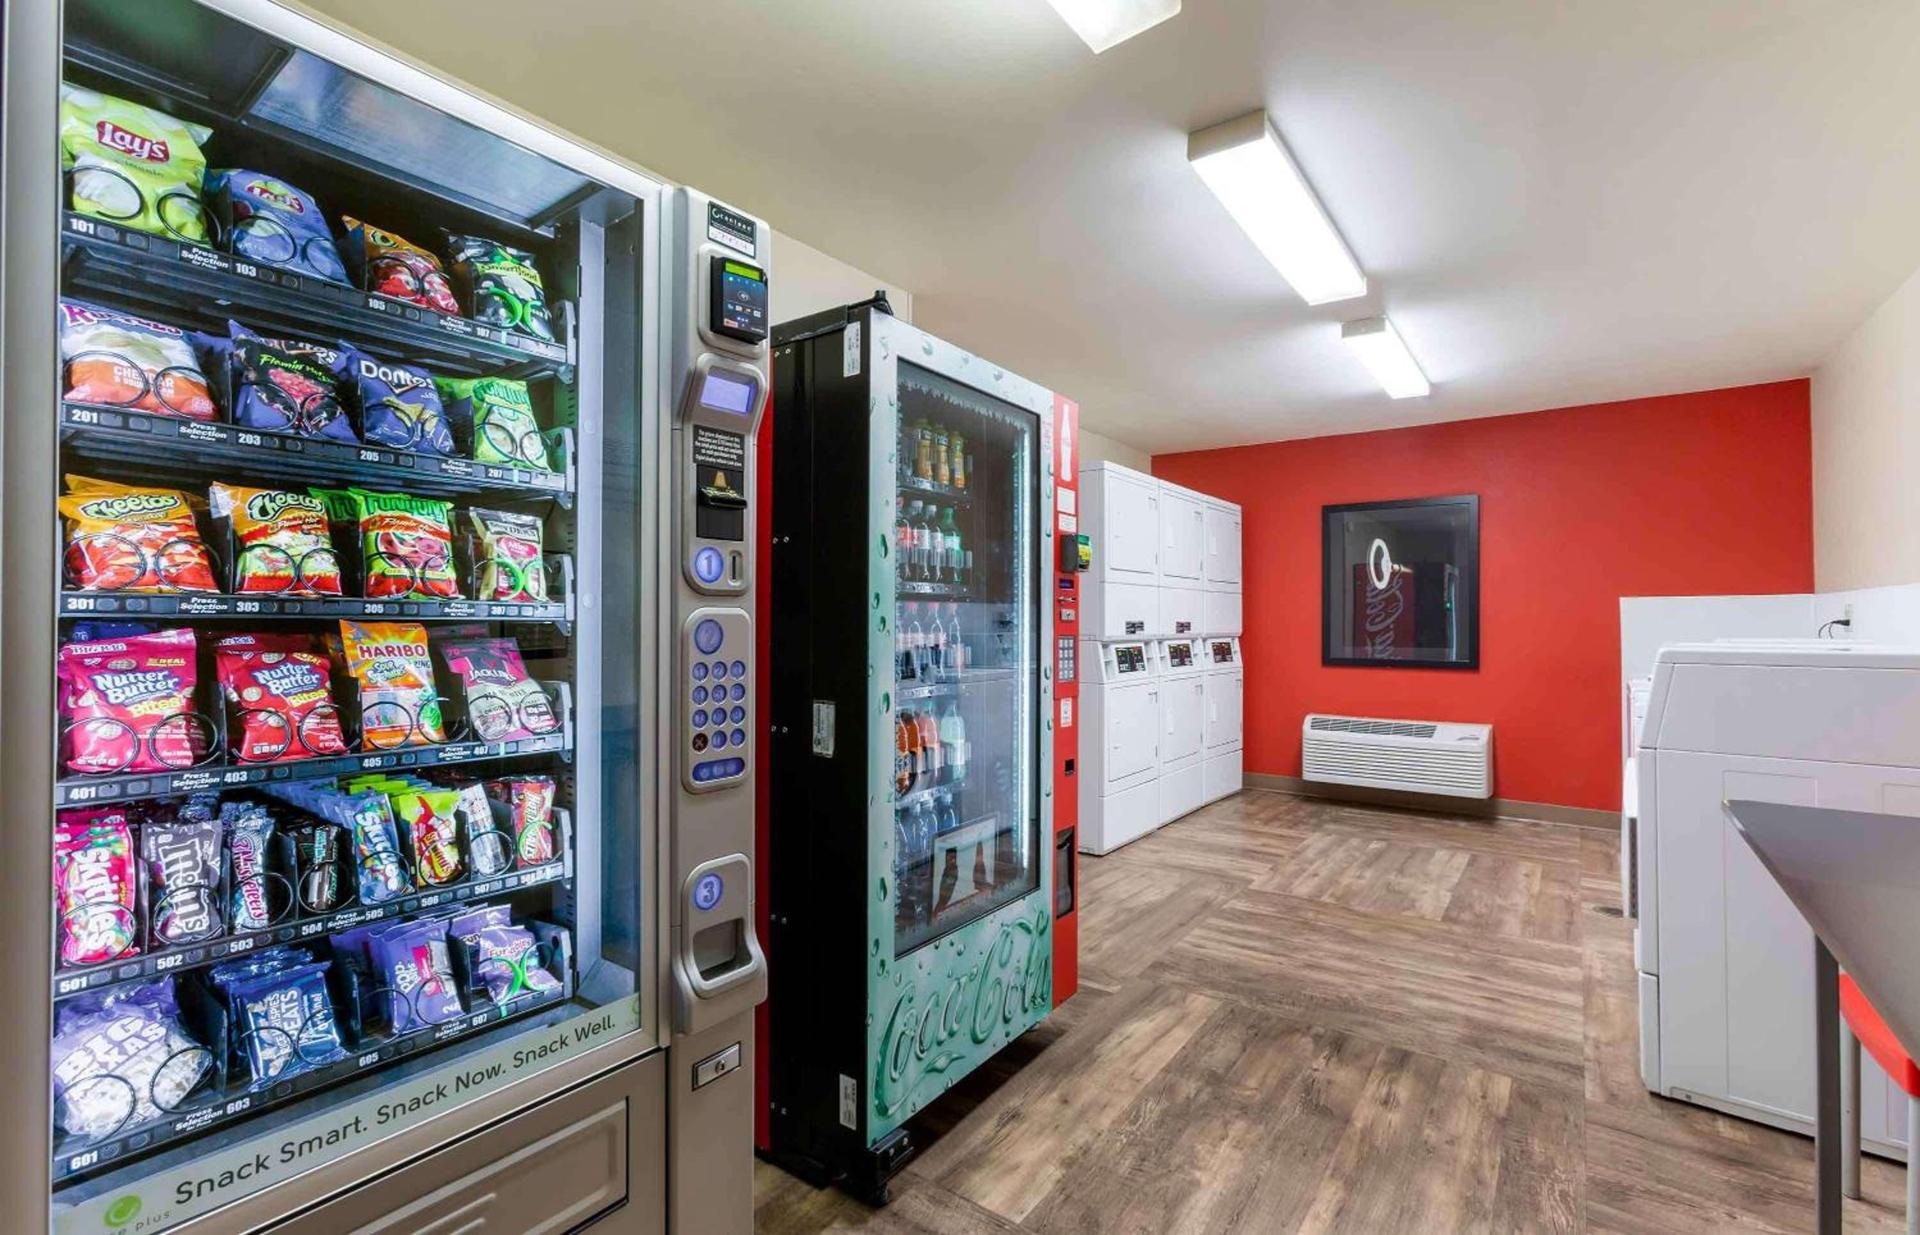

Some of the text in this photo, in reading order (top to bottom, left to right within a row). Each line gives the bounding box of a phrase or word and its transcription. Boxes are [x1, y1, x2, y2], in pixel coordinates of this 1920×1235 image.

[101, 123, 168, 161] Lay's
[70, 217, 94, 235] 101
[181, 250, 229, 270] Selection
[235, 262, 257, 277] 103
[368, 298, 386, 311] 105
[71, 408, 98, 424] 201
[179, 425, 228, 440] Selection
[238, 432, 261, 446] 203
[360, 450, 380, 462] 205
[82, 494, 178, 519] Cheetos
[67, 597, 94, 610] 301
[180, 603, 228, 611] Selection
[236, 602, 260, 613] 303
[364, 603, 384, 614] 305
[359, 644, 426, 658] HARIBO
[93, 671, 168, 691] Nutter
[106, 678, 178, 703] Butter
[362, 757, 382, 768] 405
[172, 776, 220, 787] Selection
[224, 771, 248, 783] 403
[69, 786, 96, 800] 401
[71, 848, 119, 951] Skittles
[421, 895, 439, 907] 506
[365, 909, 384, 921] 505
[301, 921, 323, 935] 504
[230, 938, 254, 952] 503
[157, 954, 183, 969] 502
[59, 978, 88, 993] 501
[472, 1013, 488, 1026] 607
[359, 1052, 378, 1067] 605
[175, 1013, 616, 1206] Snack Smart. Snack Now. Snack Well.
[226, 1097, 250, 1115] 603
[71, 1151, 98, 1169] 601
